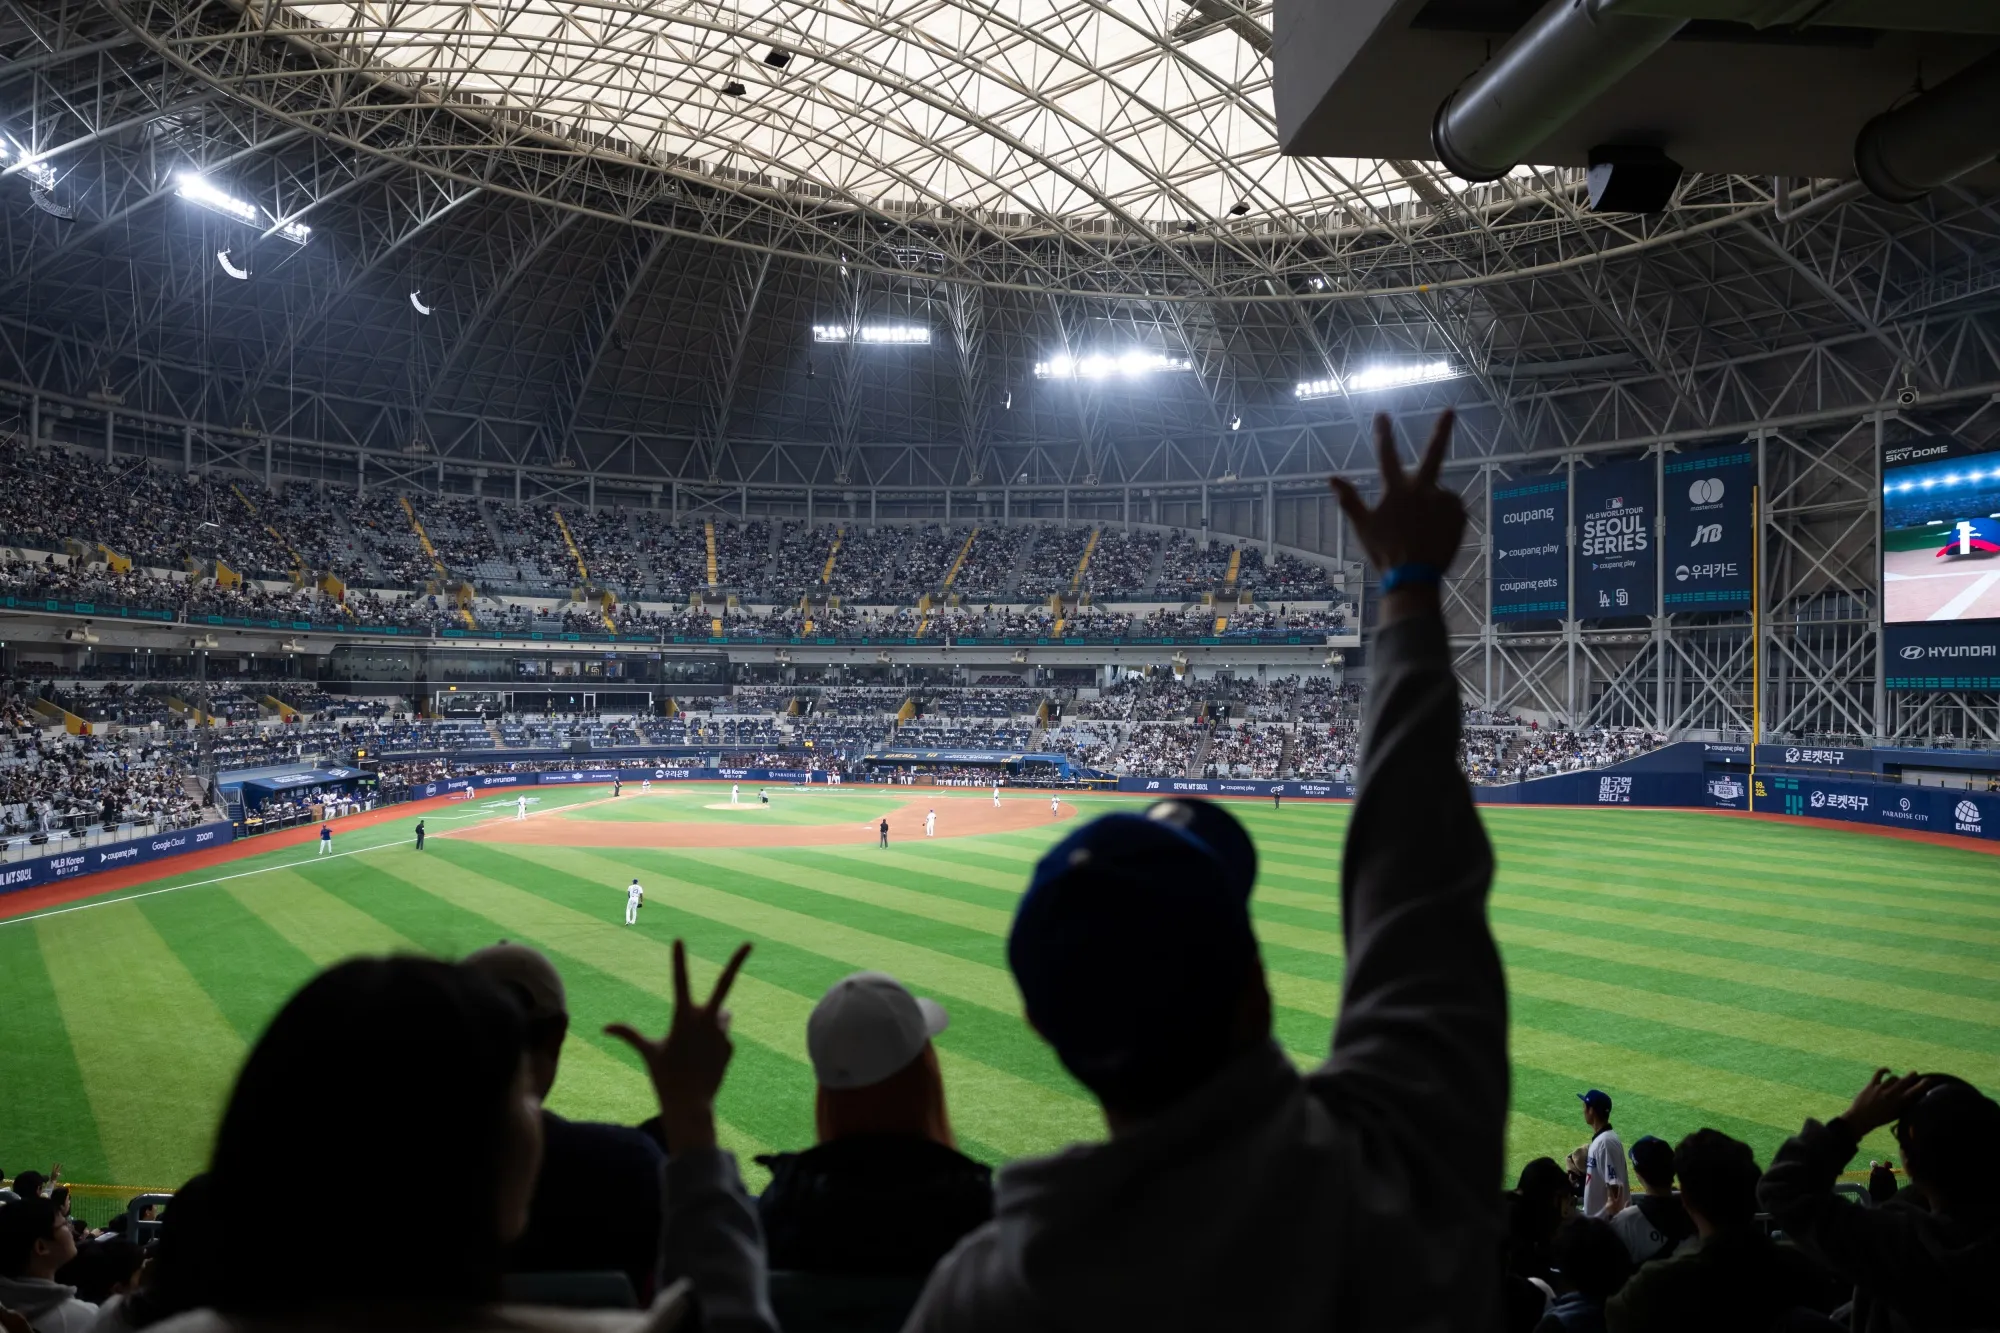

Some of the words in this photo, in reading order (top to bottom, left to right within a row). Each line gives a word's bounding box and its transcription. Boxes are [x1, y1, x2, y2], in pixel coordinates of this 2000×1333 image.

[1885, 451, 1910, 463] SKY
[1912, 445, 1948, 458] DOME
[1586, 512, 1600, 520] MLB
[1600, 509, 1624, 518] WORLD
[1625, 506, 1644, 515] TOUR
[1690, 503, 1724, 511] mastercard
[1503, 507, 1554, 525] coupang
[1584, 515, 1646, 538] SEOUL
[1690, 523, 1723, 547] JTB
[1509, 546, 1541, 557] coupang
[1542, 543, 1559, 555] play
[1582, 532, 1648, 556] SERIES
[1691, 563, 1738, 579] 우리카드
[1599, 590, 1610, 607] LA
[1616, 588, 1628, 606] SD
[1928, 645, 1996, 657] HYUNDAI
[1733, 745, 1745, 753] play
[1801, 750, 1844, 765] 로켓직구
[664, 770, 689, 778] 우리은행
[1146, 781, 1160, 789] JTB
[1173, 782, 1188, 790] SEOUL
[1827, 794, 1869, 811] 로켓직구
[1882, 810, 1913, 820] PARADISE
[1914, 813, 1929, 822] CITY
[1955, 822, 1981, 833] EARTH
[152, 840, 171, 851] Google
[171, 836, 186, 847] Cloud
[196, 831, 214, 842] zoom
[107, 851, 128, 860] coupang
[128, 848, 138, 857] play
[50, 858, 65, 870] MLB
[66, 856, 85, 867] Korea
[6, 871, 16, 885] MY
